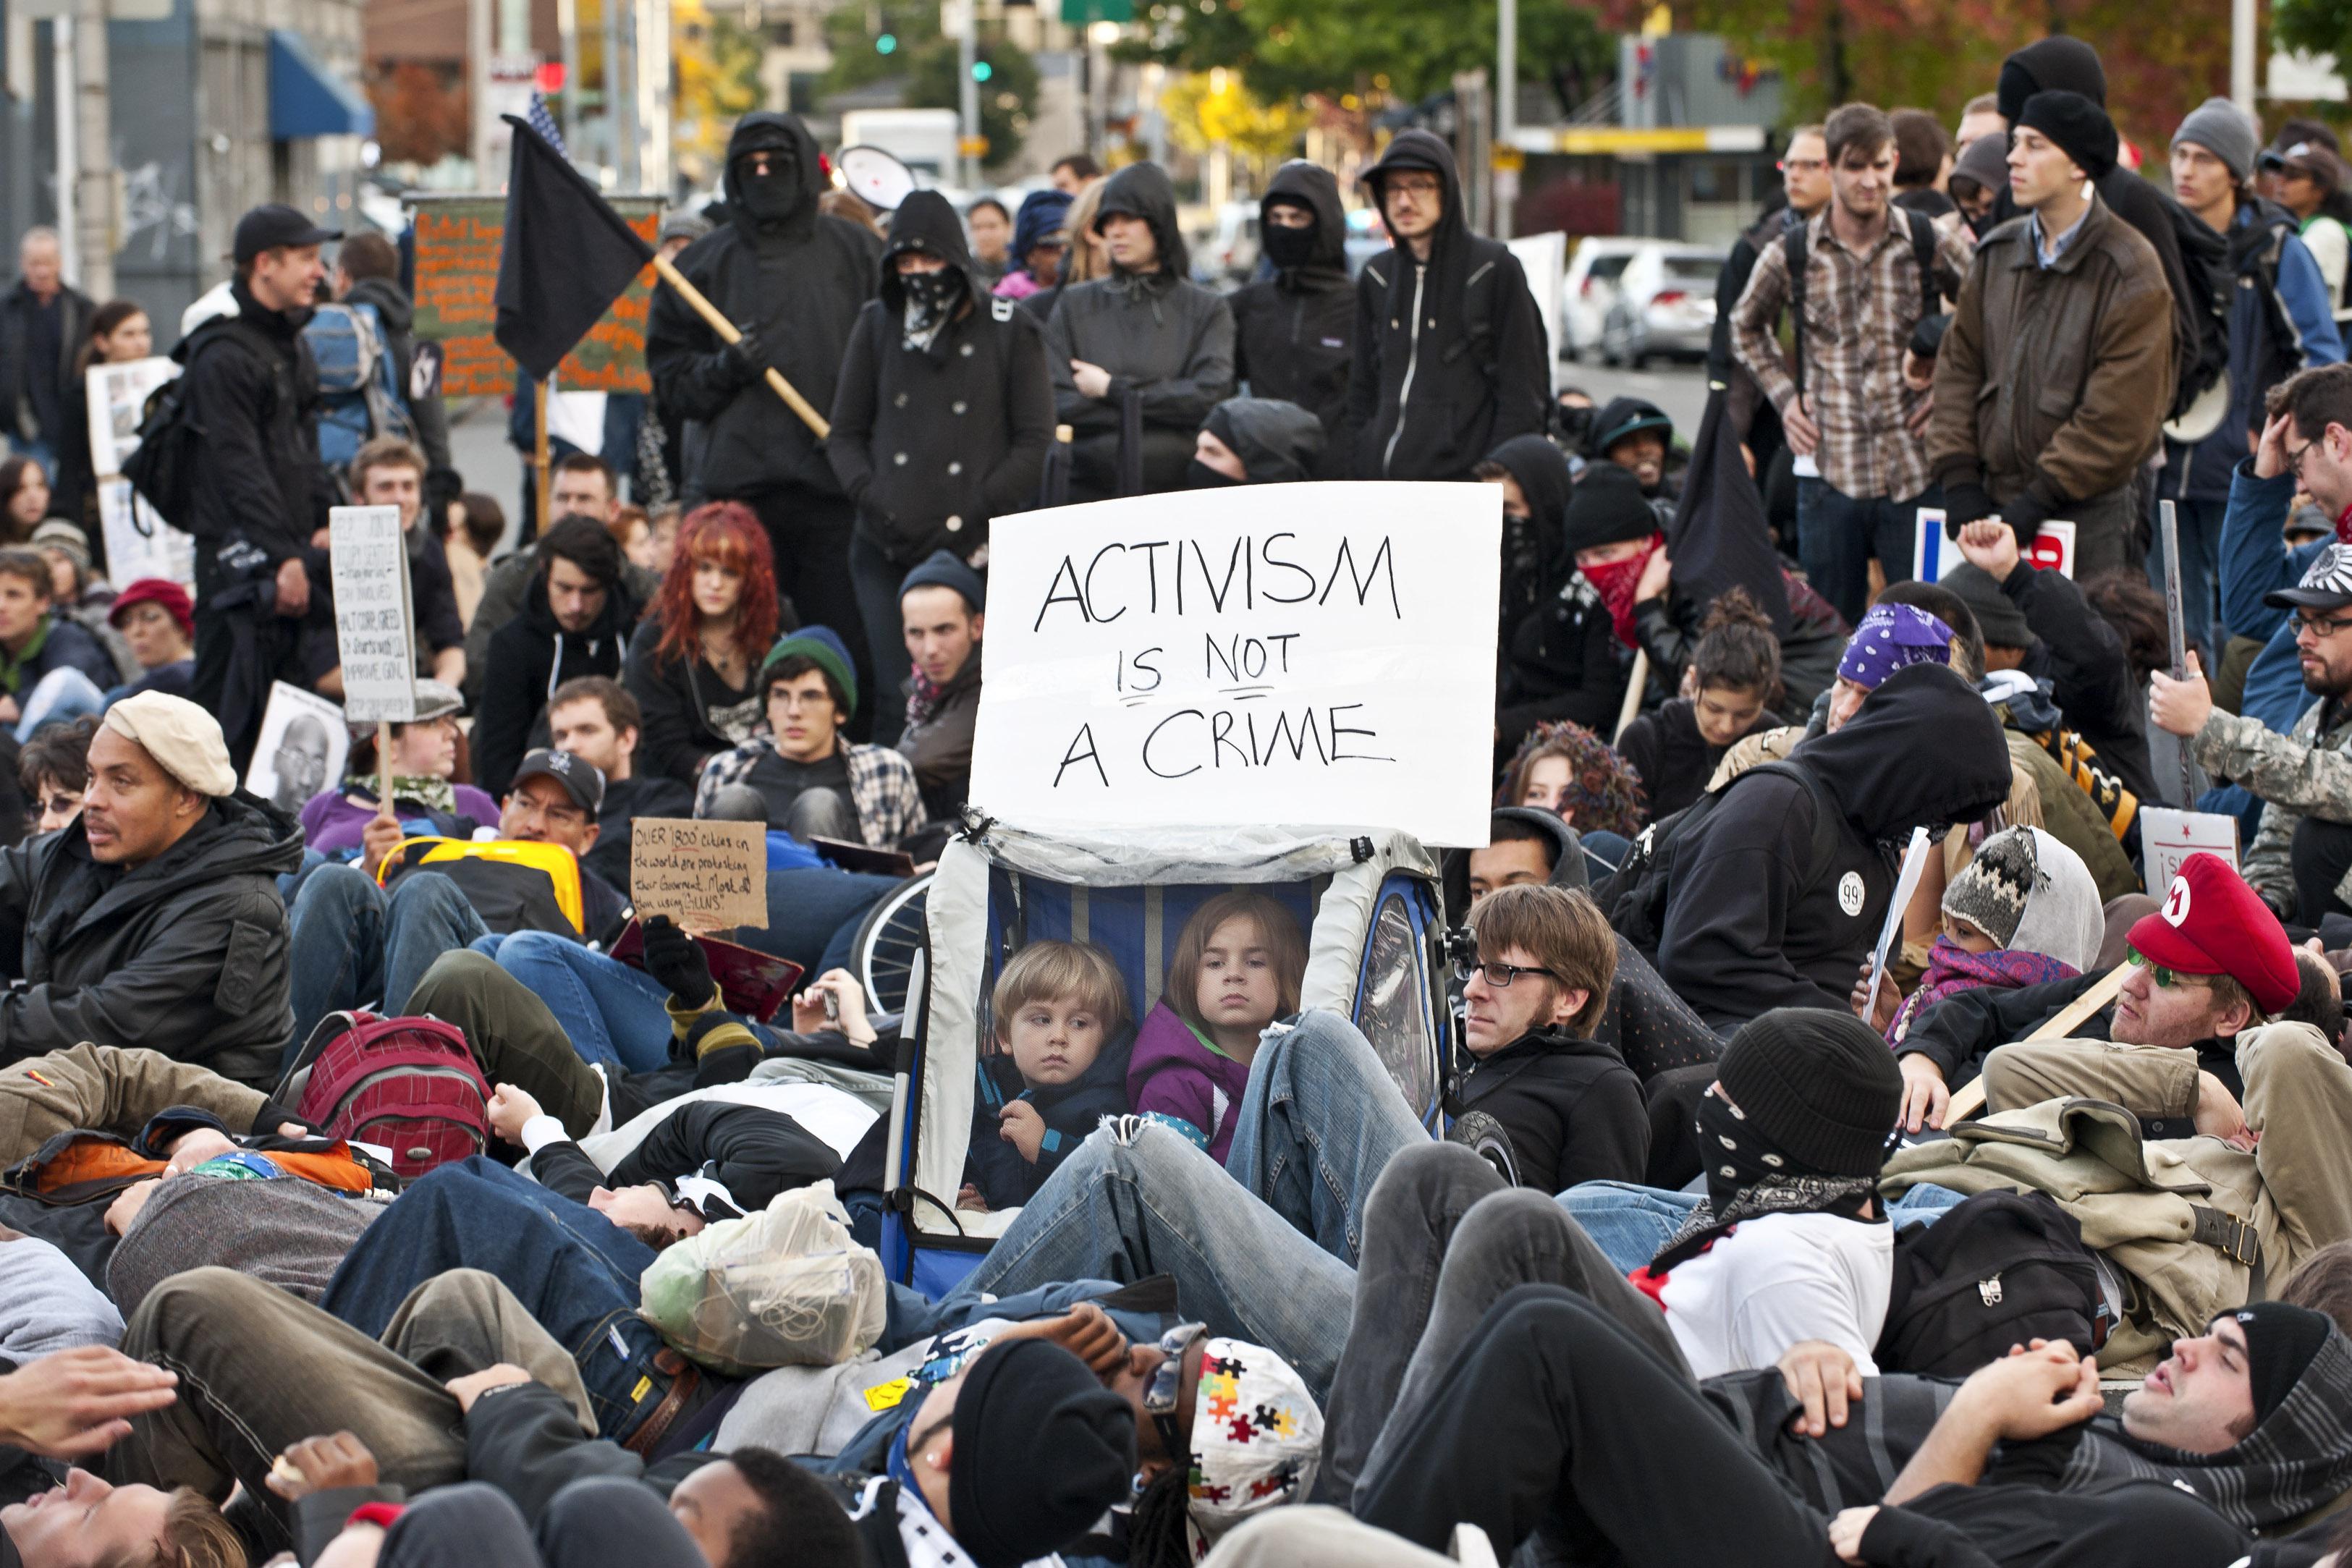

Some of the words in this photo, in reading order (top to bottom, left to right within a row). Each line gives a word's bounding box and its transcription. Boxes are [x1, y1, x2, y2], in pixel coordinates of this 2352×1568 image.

[1033, 533, 1402, 632] ACTIVISM
[1117, 646, 1164, 692] IS
[1206, 632, 1301, 683] NOT
[1053, 722, 1110, 789] A
[1142, 703, 1397, 779] CRIME
[635, 826, 666, 847] OVER
[634, 852, 648, 868] the
[649, 855, 680, 869] world
[681, 857, 696, 872] are
[698, 855, 749, 874] protesting
[708, 873, 738, 895] Most
[657, 898, 685, 915] using
